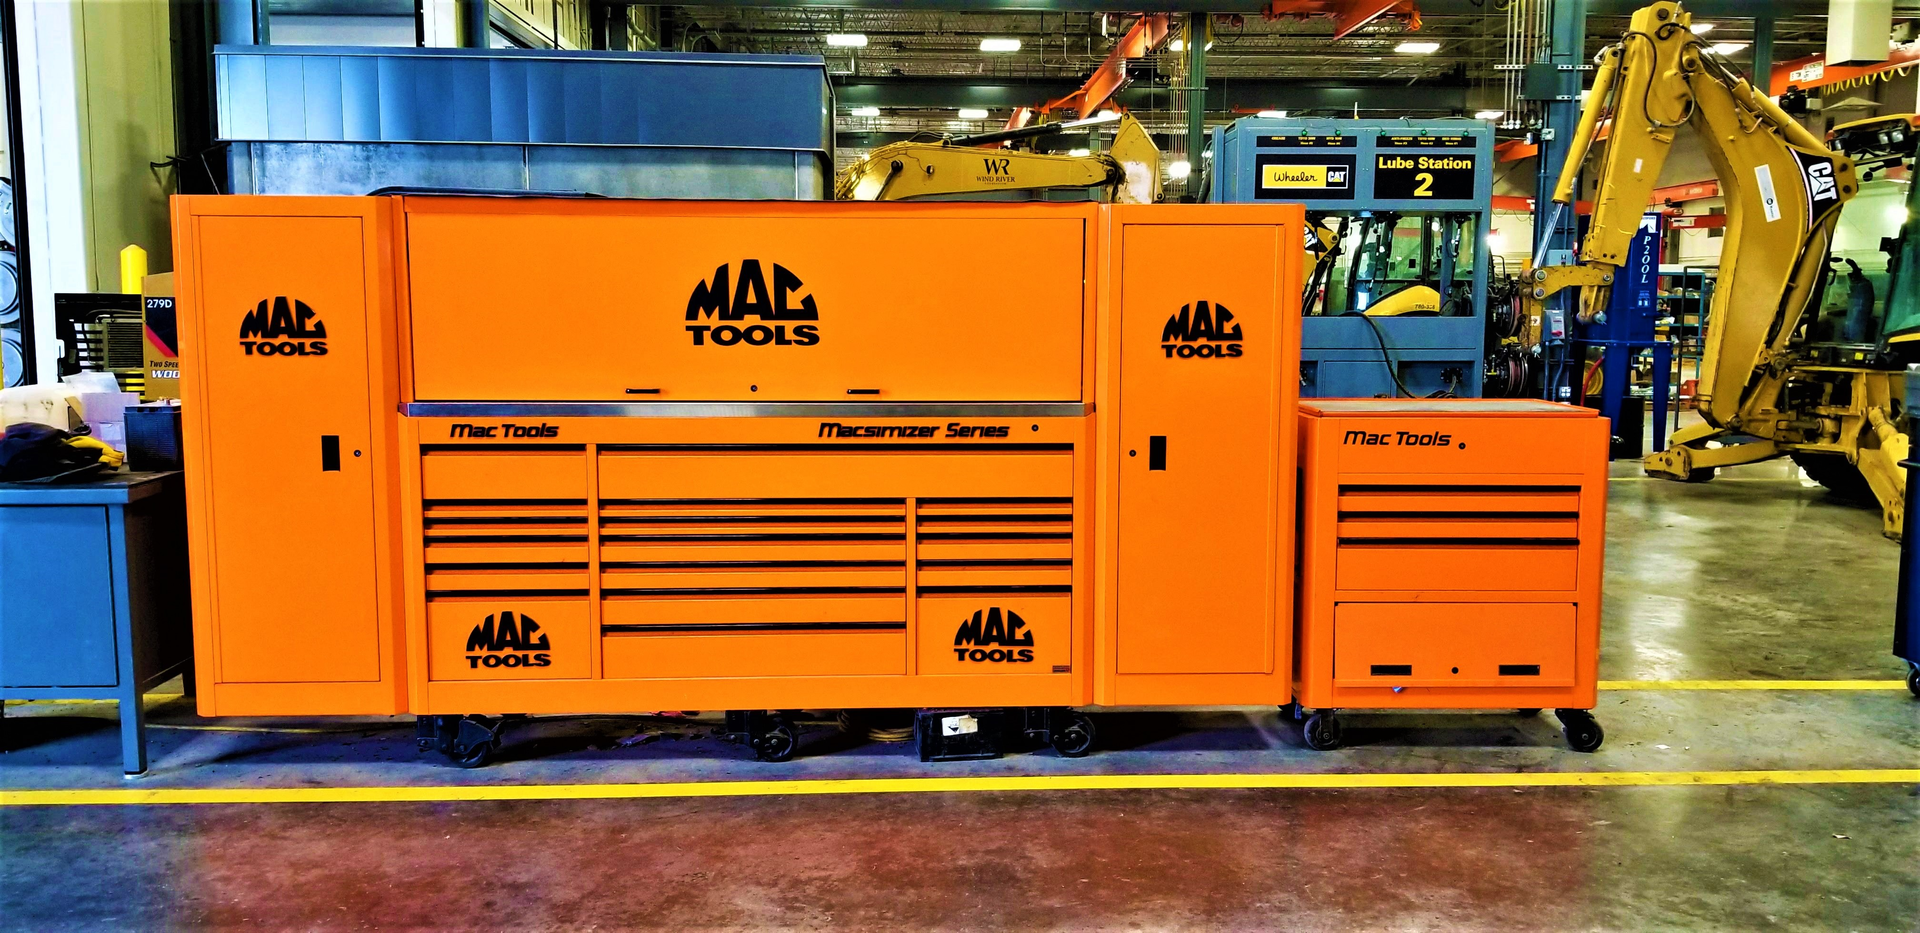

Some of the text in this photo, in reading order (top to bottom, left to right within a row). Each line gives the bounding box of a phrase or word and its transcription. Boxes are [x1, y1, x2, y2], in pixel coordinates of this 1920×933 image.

[983, 158, 1010, 175] WR
[1378, 156, 1472, 169] Lube Station
[1273, 171, 1318, 182] Wheeler
[1328, 171, 1346, 182] CAT
[1414, 173, 1433, 196] 2
[1808, 162, 1837, 201] CAT
[686, 259, 819, 321] MAC
[147, 299, 172, 308] 279D
[240, 296, 327, 338] MAC
[1162, 301, 1243, 341] MAC
[685, 325, 820, 347] TOOLS
[240, 341, 327, 357] TOOLS
[1161, 343, 1243, 358] TOOLS
[450, 423, 559, 438] Mac Tools
[818, 422, 1010, 438] Macsimizer Series
[1343, 431, 1452, 446] Mac Tools
[466, 611, 551, 651] MAC
[954, 607, 1034, 646] MAC
[465, 653, 551, 668] TOOLS
[953, 648, 1034, 663] TOOLS
